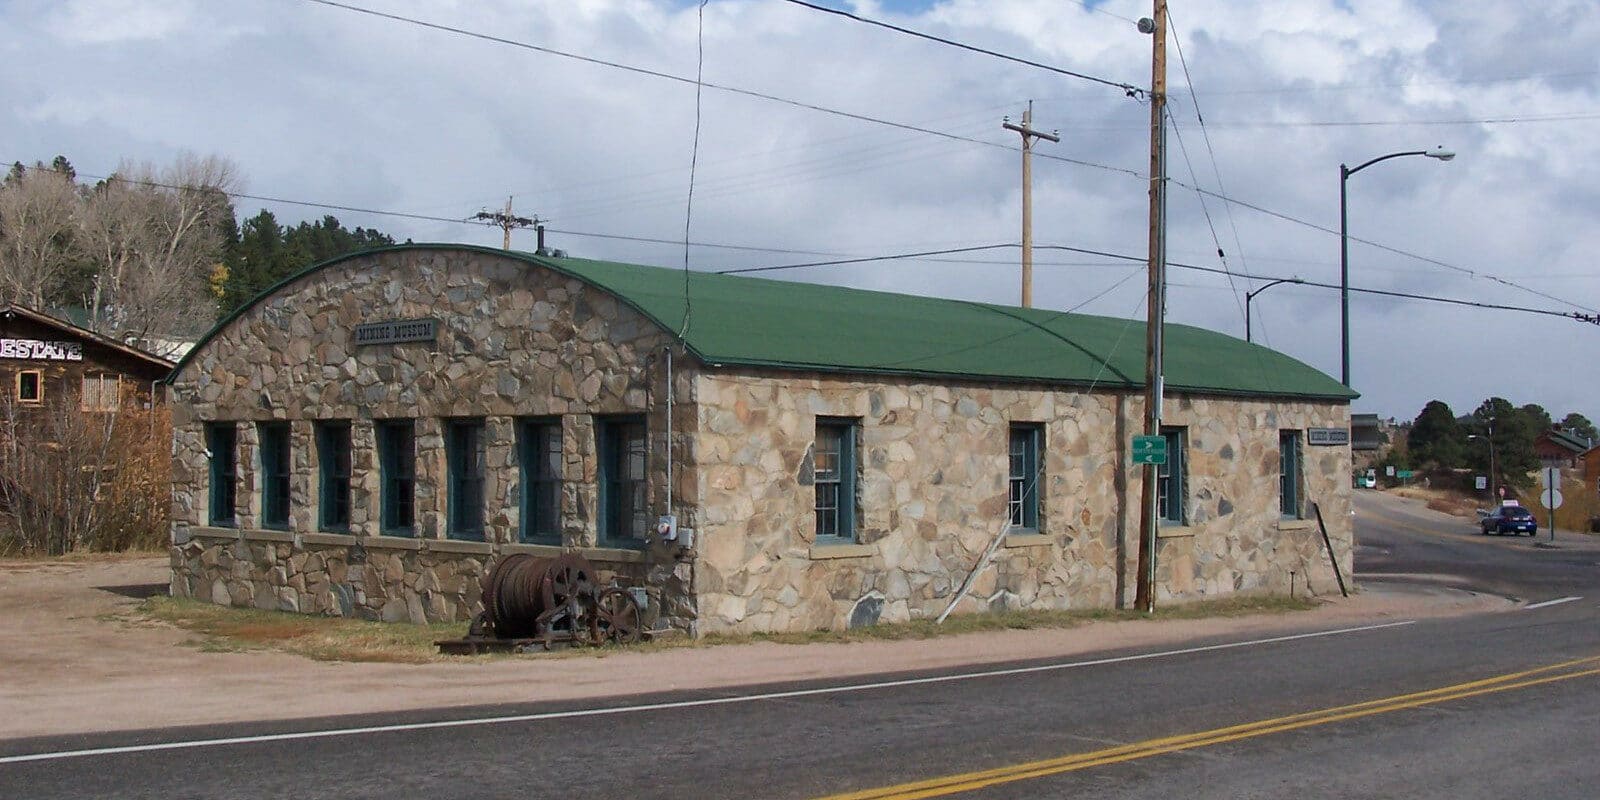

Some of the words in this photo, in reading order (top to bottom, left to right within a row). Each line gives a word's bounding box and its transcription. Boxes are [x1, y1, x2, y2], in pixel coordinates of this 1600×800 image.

[359, 326, 390, 341] MINING
[394, 323, 431, 339] MUSEUM
[0, 339, 82, 360] ESTATE
